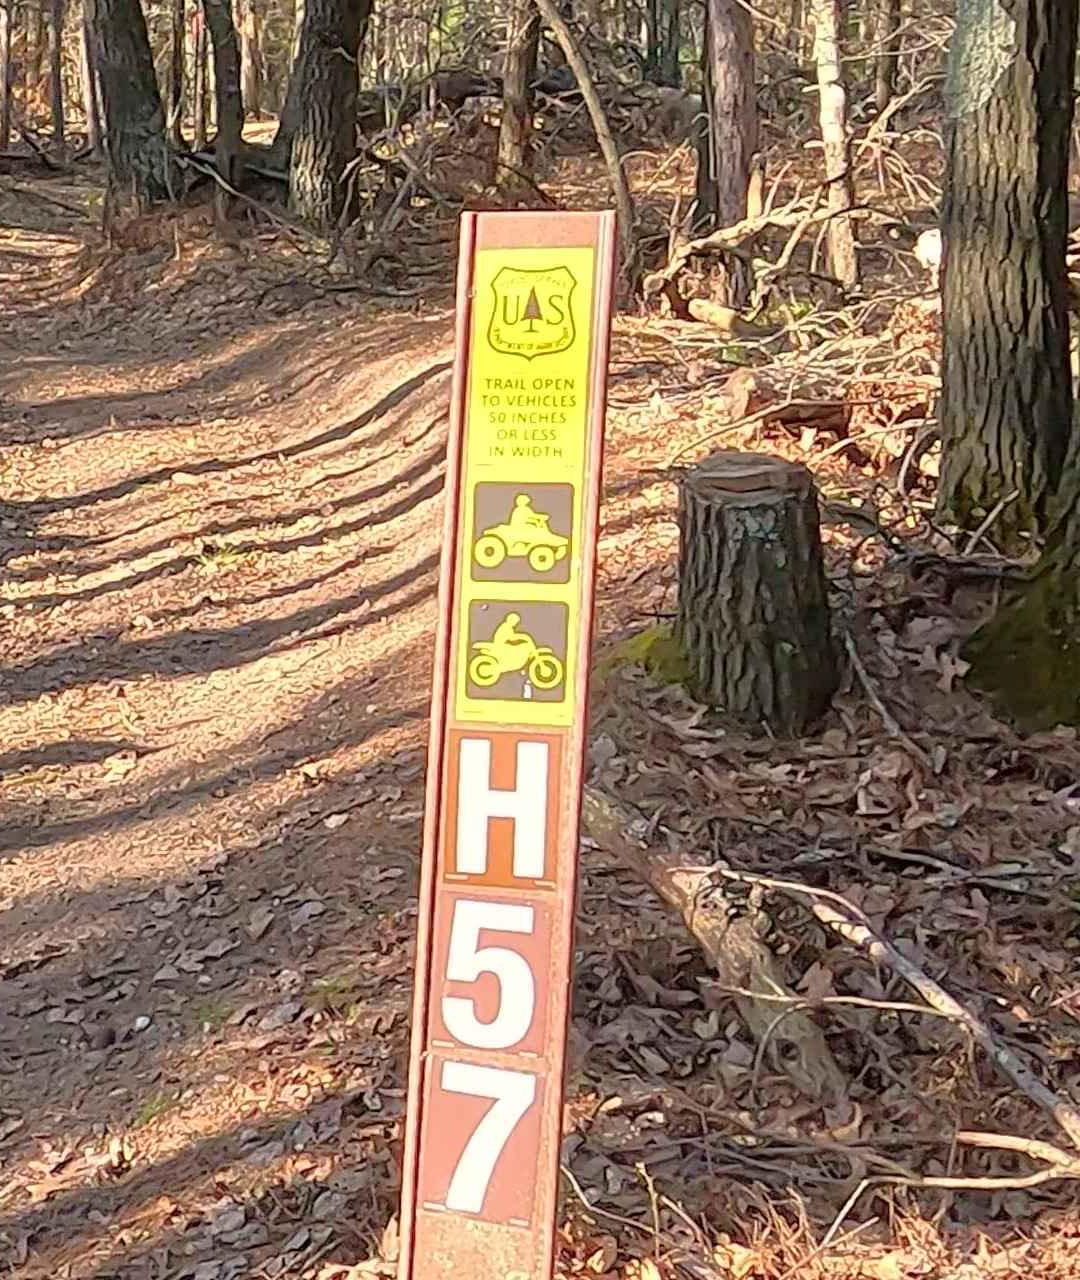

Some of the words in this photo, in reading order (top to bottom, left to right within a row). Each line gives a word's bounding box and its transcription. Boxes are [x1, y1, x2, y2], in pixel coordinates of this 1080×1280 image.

[502, 295, 520, 325] U
[547, 294, 565, 325] S
[485, 378, 526, 390] TRAIL
[532, 378, 575, 390] OPEN
[482, 395, 500, 407] TO
[507, 395, 577, 407] VEHICLES
[489, 412, 507, 423] 50
[511, 412, 567, 424] INCHES
[496, 429, 518, 441] OR
[524, 429, 557, 441] LESS
[489, 446, 505, 457] IN
[511, 446, 562, 457] WIDTH
[455, 737, 549, 878] H
[440, 898, 535, 1049] 5
[440, 1060, 536, 1214] 7
